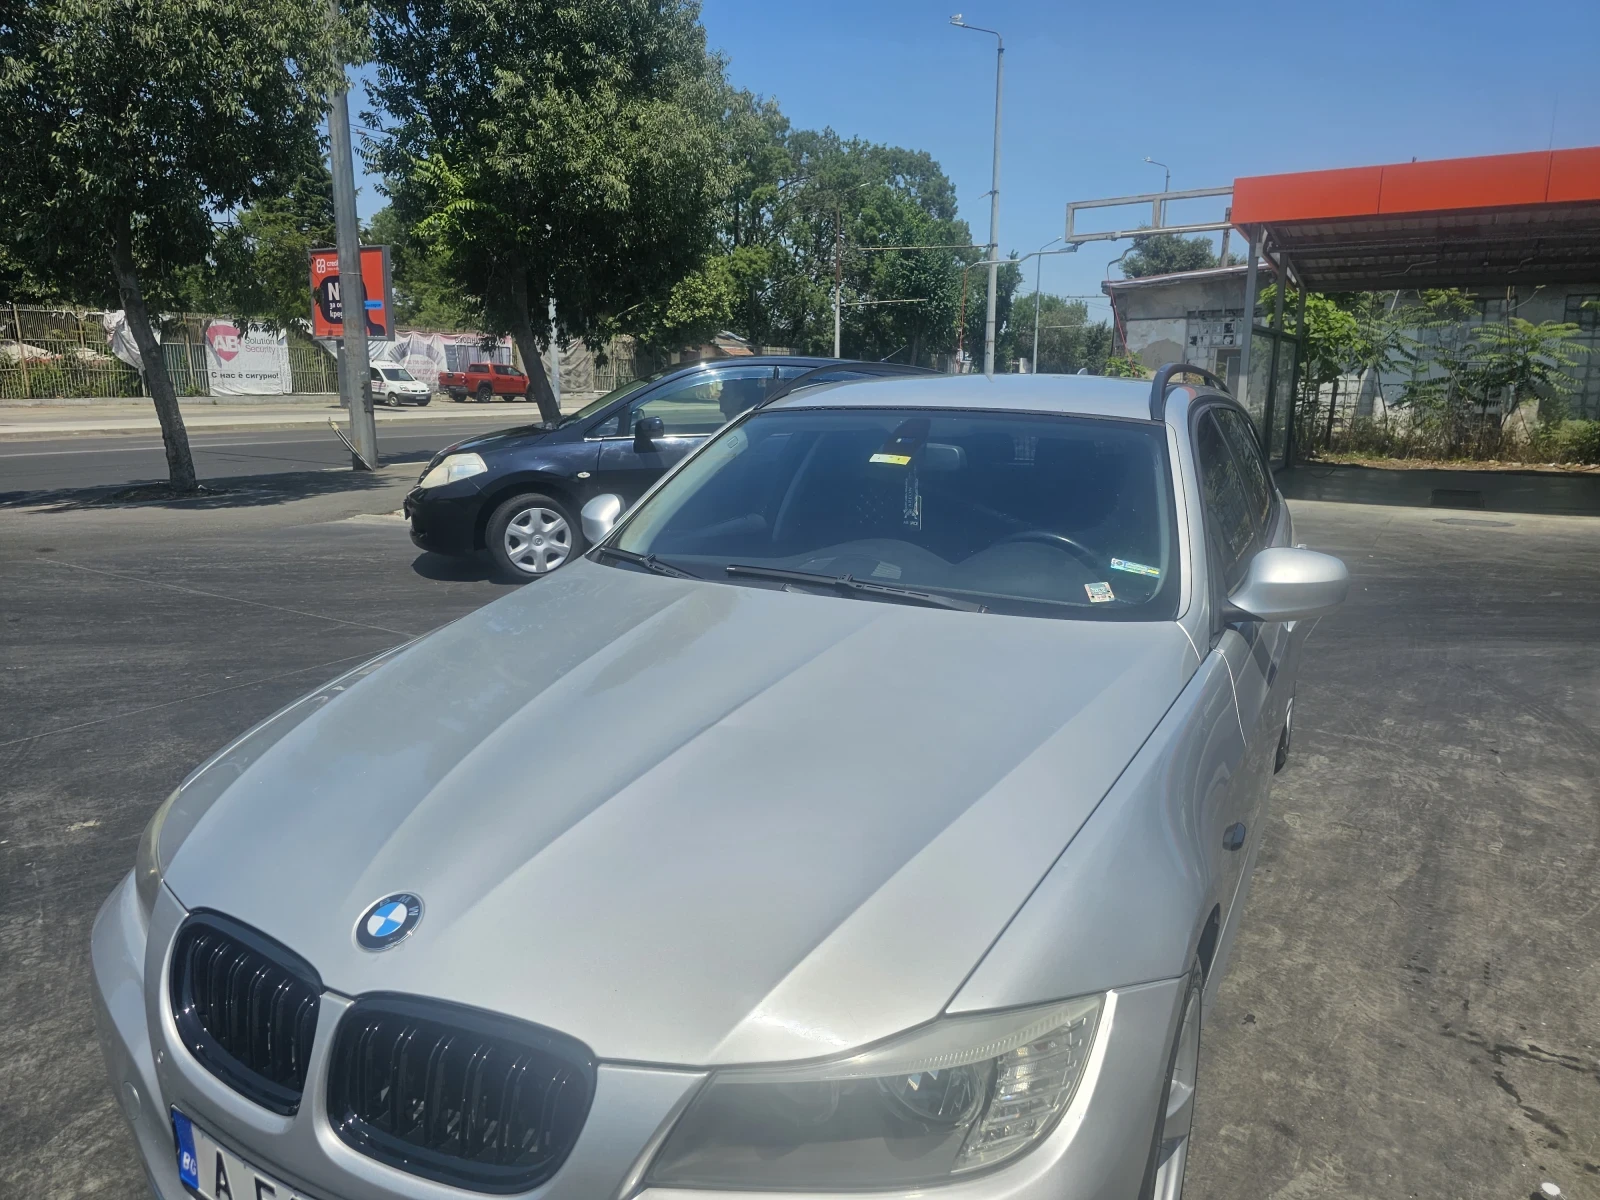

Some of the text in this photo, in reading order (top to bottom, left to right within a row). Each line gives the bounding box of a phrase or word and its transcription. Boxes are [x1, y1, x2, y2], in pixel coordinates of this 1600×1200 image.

[328, 282, 340, 301] N
[213, 335, 239, 352] AB
[244, 336, 275, 345] Solution
[245, 345, 276, 354] Security
[211, 371, 218, 379] С
[245, 372, 279, 381] сигурно!
[379, 894, 420, 916] BMW
[182, 1151, 198, 1176] BG
